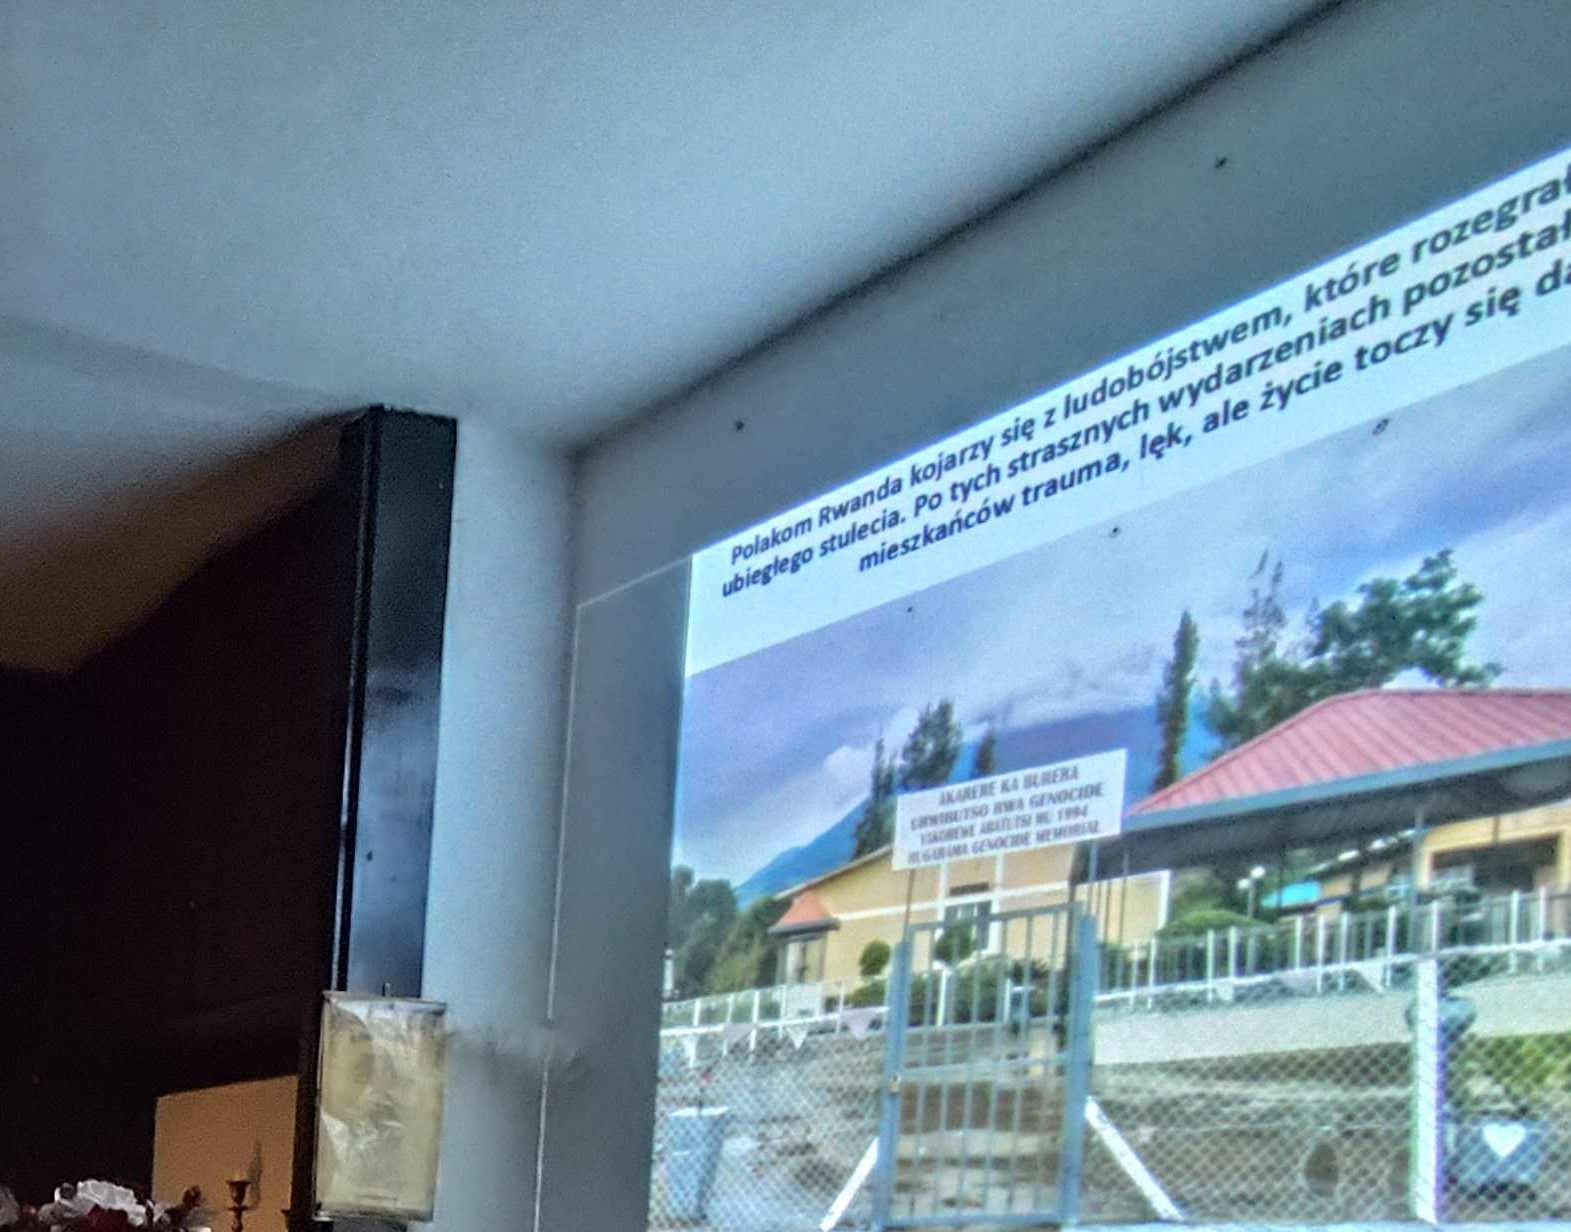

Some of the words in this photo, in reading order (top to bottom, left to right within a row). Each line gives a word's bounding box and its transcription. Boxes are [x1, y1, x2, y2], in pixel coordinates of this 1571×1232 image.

[722, 546, 814, 598] ubiegłego
[819, 506, 907, 558] stulecia.
[914, 491, 942, 518] Po
[949, 462, 1001, 503] tych
[1007, 398, 1149, 478] strasznych
[1158, 294, 1391, 413] wydarzeniach
[731, 516, 812, 565] Polakom
[818, 476, 902, 528] Rwanda
[910, 434, 995, 487] kojarzy
[1000, 416, 1035, 448] się
[1043, 407, 1057, 428] z
[1063, 305, 1292, 419] ludobójstwem,
[1304, 252, 1400, 312] które
[858, 493, 1015, 573] mieszkańców
[1021, 450, 1130, 507] trauma,
[1139, 423, 1193, 460] lęk,
[1202, 399, 1250, 433] ale
[1259, 361, 1343, 411] życie
[1353, 312, 1454, 371] toczy
[1465, 286, 1521, 328] się
[1029, 781, 1105, 808] GENOCIDE
[1057, 803, 1088, 821] 1994
